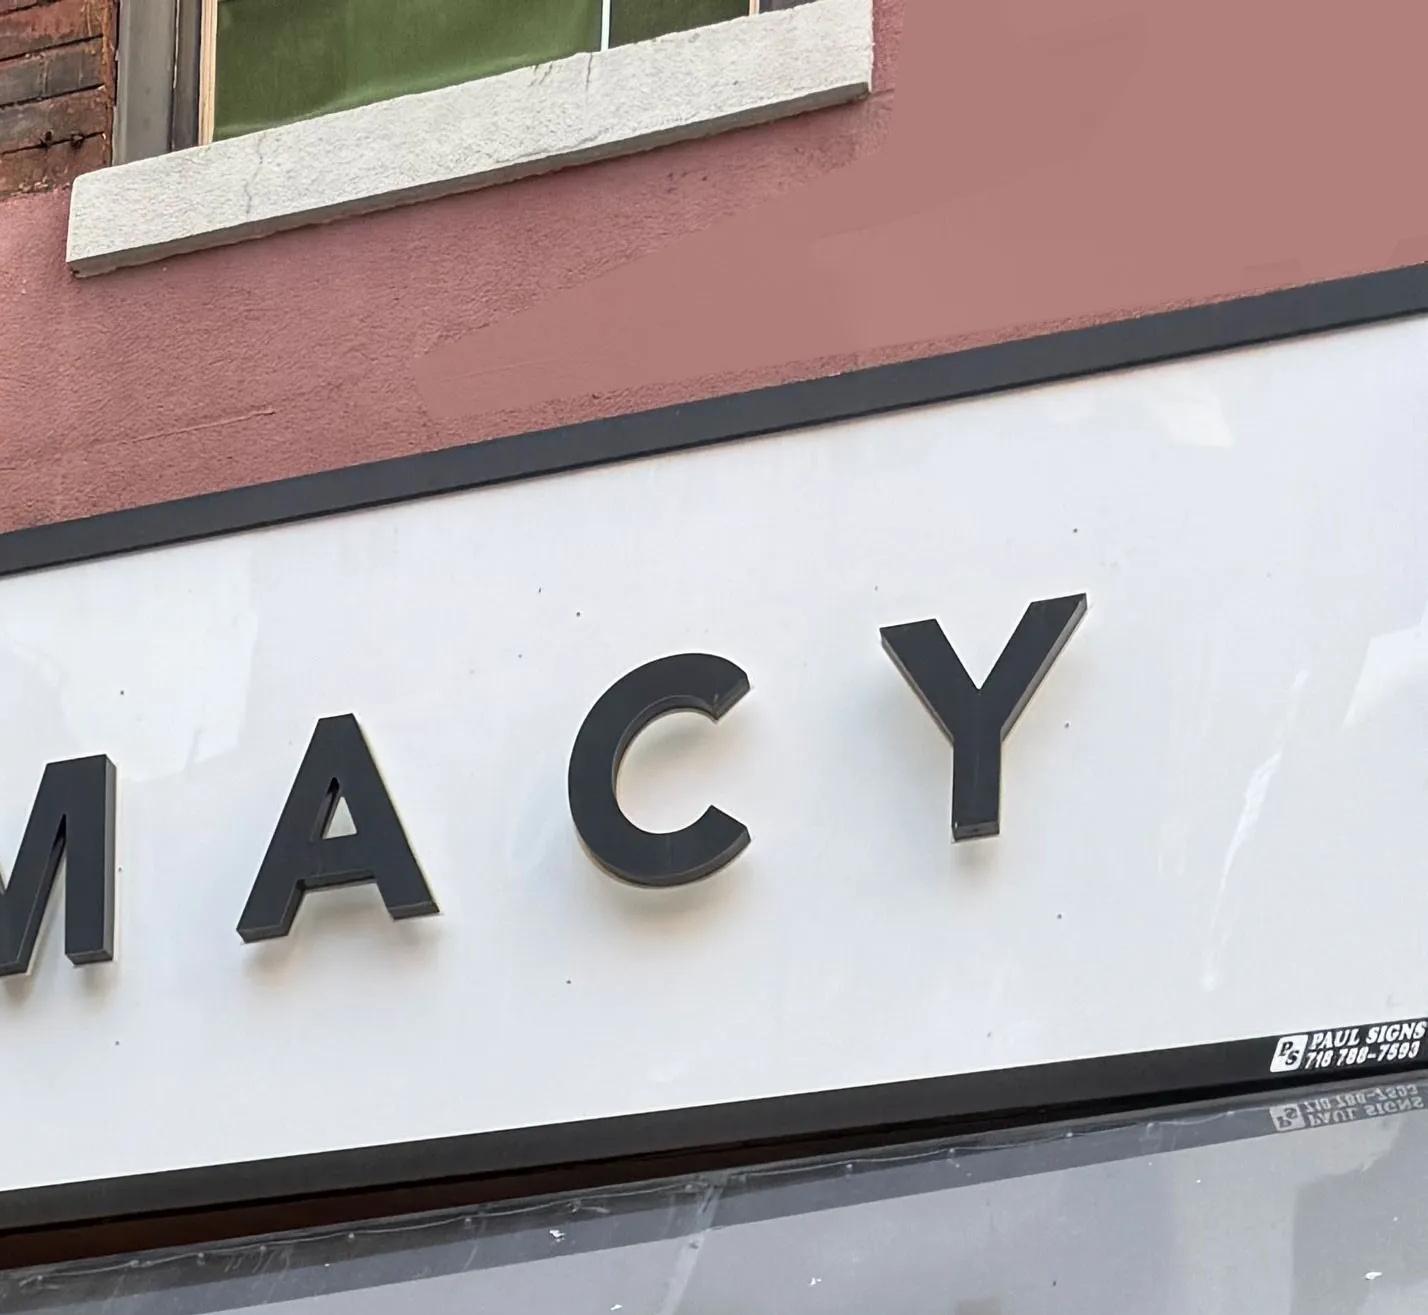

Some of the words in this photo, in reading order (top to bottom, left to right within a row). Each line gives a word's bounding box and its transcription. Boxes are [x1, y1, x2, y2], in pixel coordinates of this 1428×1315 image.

[1309, 1028, 1360, 1050] PAUL
[1366, 1020, 1428, 1044] SIGNS
[1304, 1050, 1334, 1070] 718
